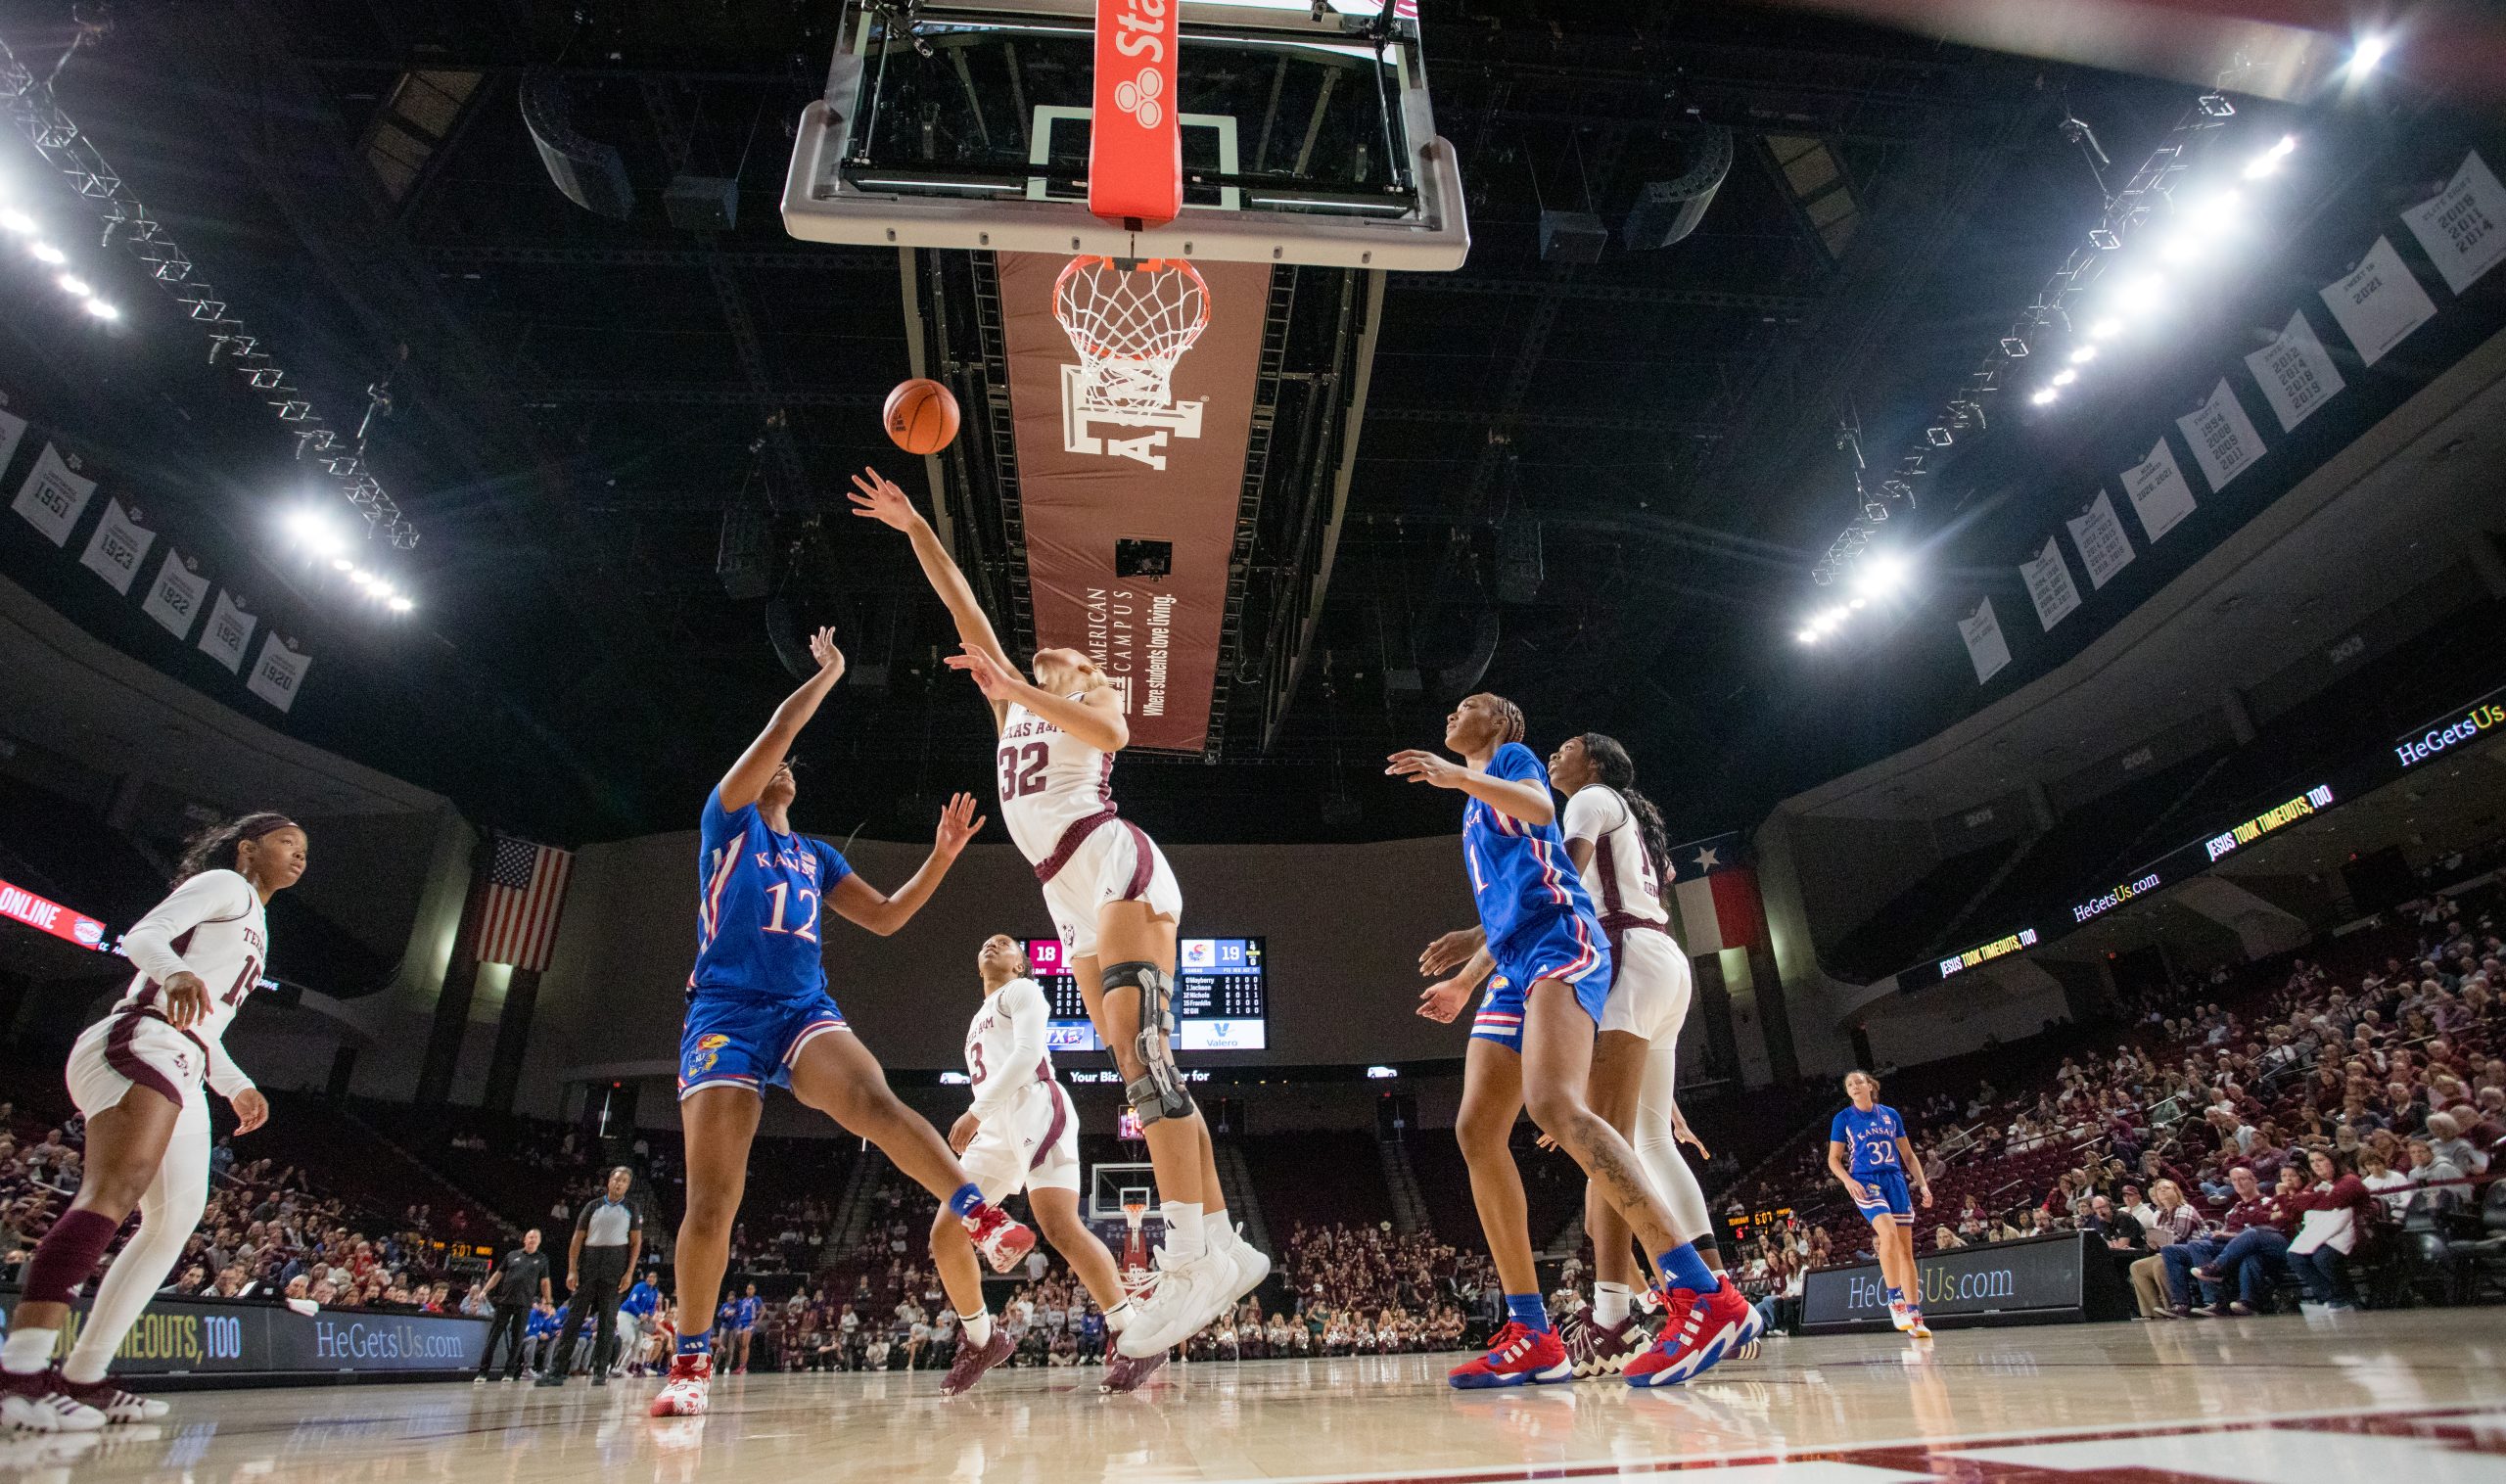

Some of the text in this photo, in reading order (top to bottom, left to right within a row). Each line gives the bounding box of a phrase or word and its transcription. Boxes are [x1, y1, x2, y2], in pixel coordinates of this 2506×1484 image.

[1116, 0, 1165, 63] Sta
[2448, 207, 2484, 241] 2011
[2456, 218, 2495, 254] 2014
[2352, 276, 2383, 306] 2021
[2279, 357, 2308, 386] 2014
[2286, 369, 2315, 397] 2018
[2292, 381, 2322, 410] 2019
[2206, 423, 2232, 449] 2008
[2212, 434, 2239, 461] 2009
[2220, 447, 2245, 471] 2011
[34, 481, 70, 519] 1951
[100, 534, 134, 570] 1923
[158, 582, 189, 615] 1922
[216, 623, 240, 651] 1921
[1087, 588, 1107, 670] AMERICAN
[1114, 591, 1132, 671] CAMPUS
[1143, 594, 1177, 716] Where students love living.
[262, 662, 292, 690] 1920
[999, 742, 1049, 802] 32
[2205, 784, 2333, 862] JESUS TOOK TIMEOUTS, TOO
[0, 887, 61, 930] ONLINE
[761, 882, 817, 943] 12
[2073, 873, 2160, 922] HeGetsUs.com
[1036, 946, 1056, 961] 18
[1222, 946, 1240, 960] 19
[1940, 928, 2037, 978] JESUS TOOK TIMEOUTS, TOO
[971, 1042, 987, 1086] 3
[1070, 1072, 1098, 1082] Your
[1192, 1070, 1210, 1081] for
[1866, 1141, 1895, 1164] 32
[1755, 1211, 1772, 1225] 6:07
[1848, 1269, 2014, 1309] HeGsUs.com
[204, 1316, 241, 1358] TOO
[315, 1322, 464, 1358] HeGetsUs.com
